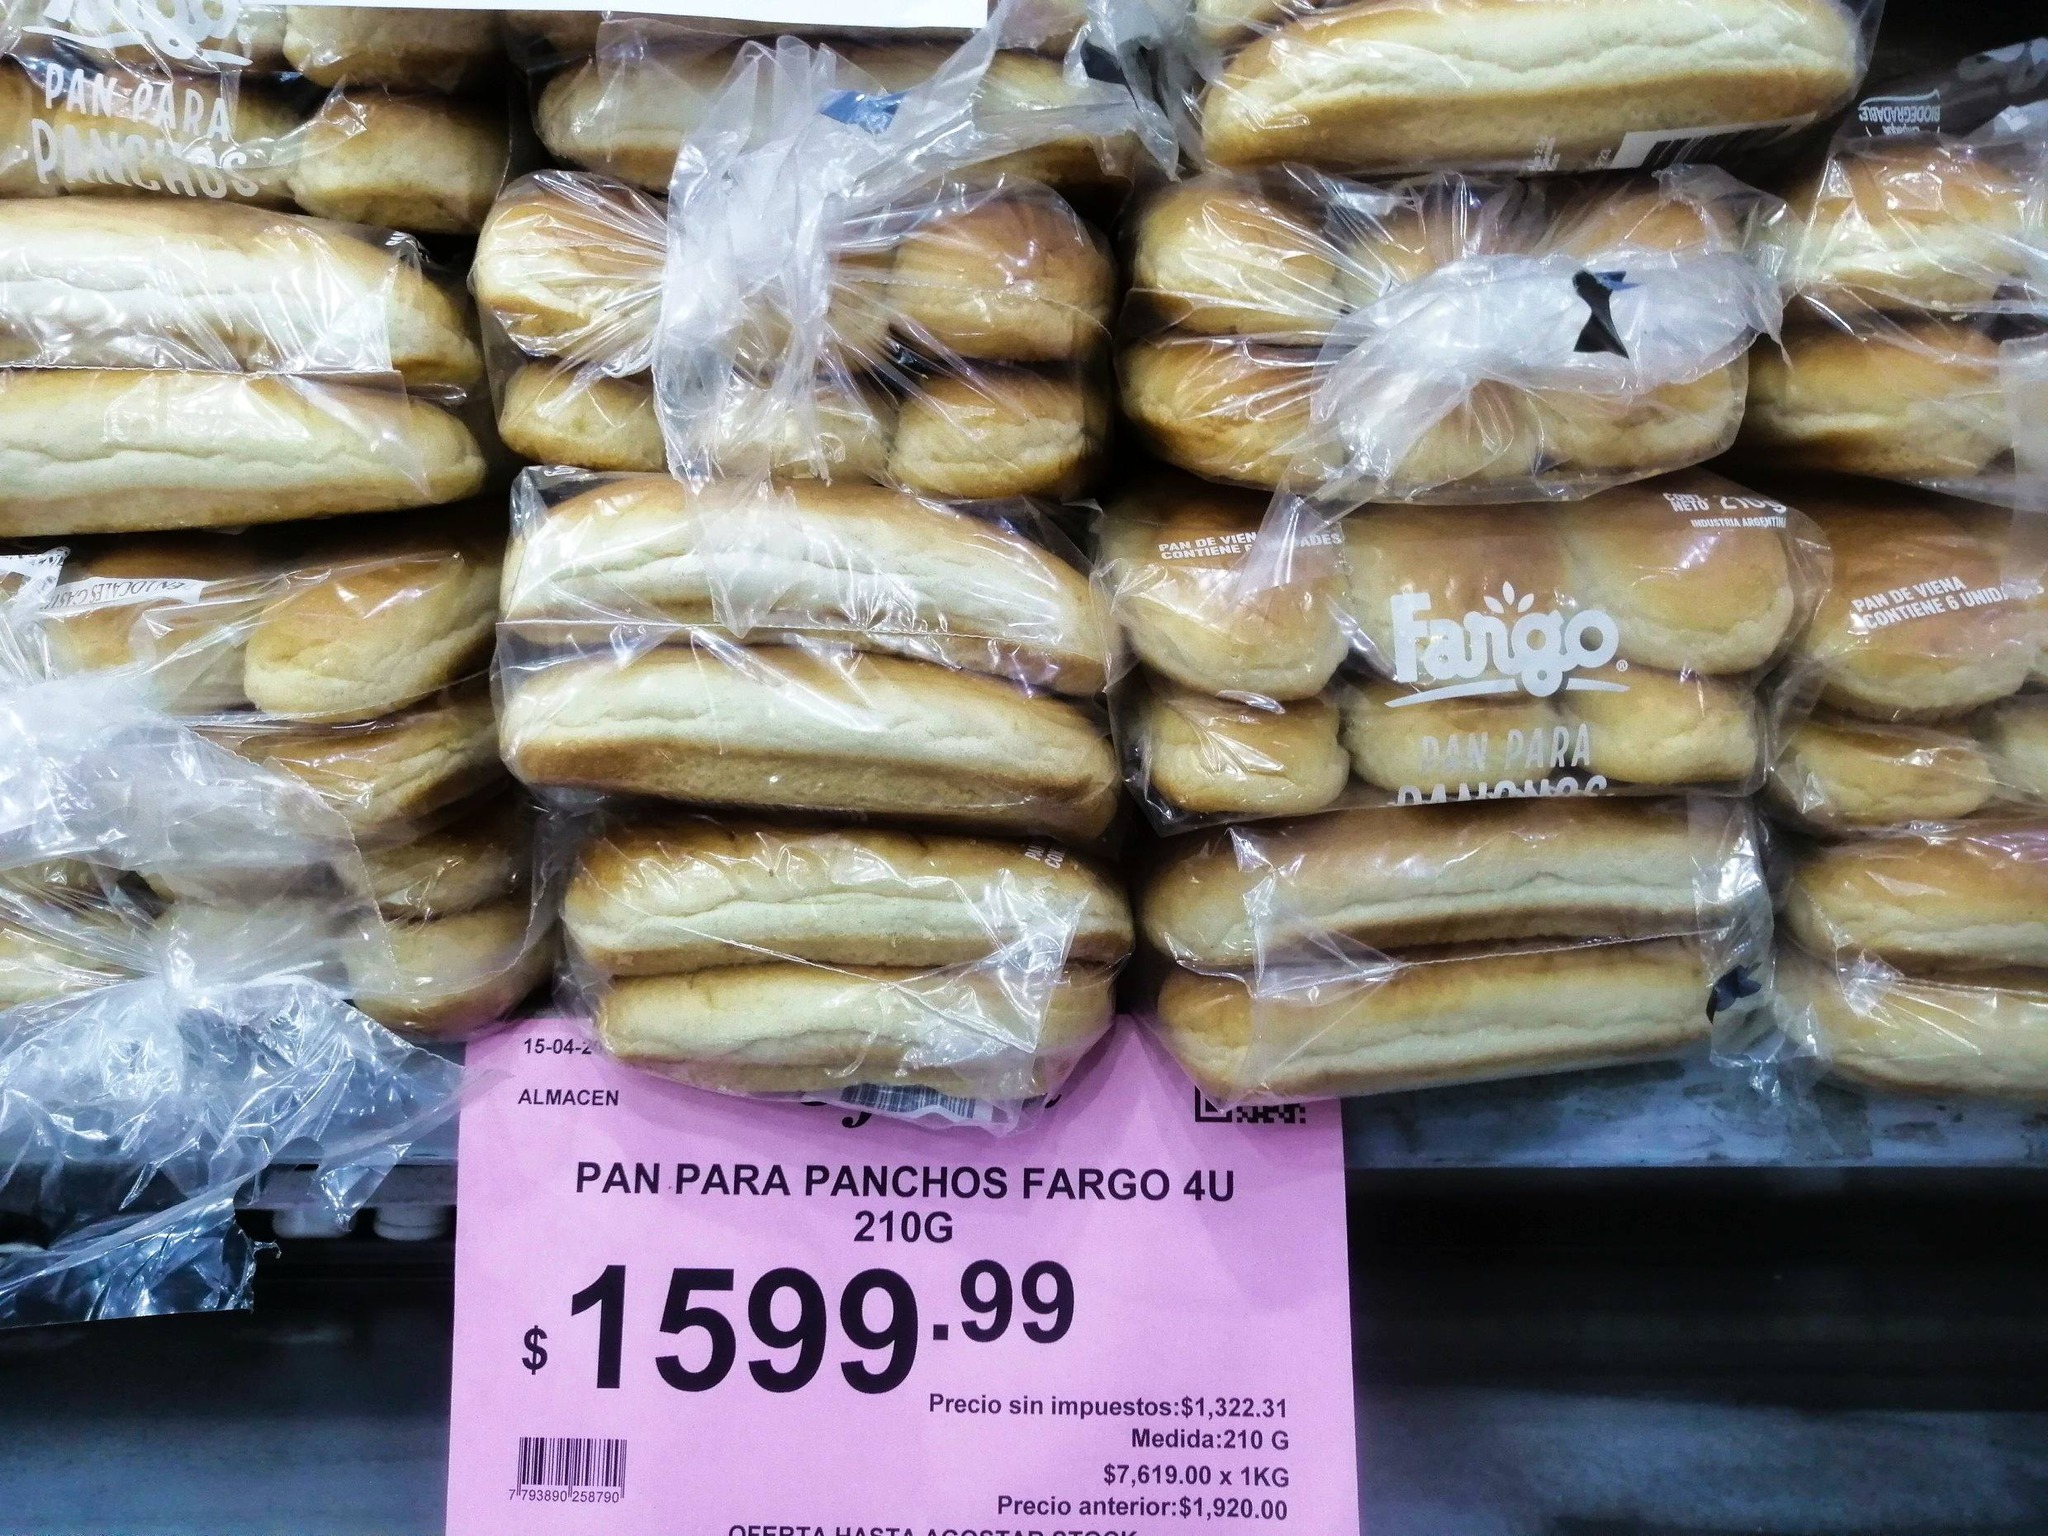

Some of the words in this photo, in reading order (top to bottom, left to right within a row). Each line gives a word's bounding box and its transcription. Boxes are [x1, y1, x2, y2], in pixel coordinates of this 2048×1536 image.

[45, 63, 118, 118] PAN
[132, 82, 230, 142] PARA
[31, 118, 259, 199] PANCHOS
[1670, 500, 1709, 512] NETO
[1690, 518, 1741, 528] INDUSTRIA
[1158, 541, 1191, 552] PAN
[1195, 537, 1216, 548] DE
[1220, 531, 1257, 545] VIEN
[1161, 544, 1241, 560] CONTIENE
[1851, 592, 1889, 613] PAN
[1888, 587, 1914, 604] DE
[1913, 576, 1967, 598] VIENA
[1862, 597, 1946, 630] CONTIENE
[1945, 595, 1960, 610] 6
[1391, 592, 1619, 697] Fargo
[1421, 731, 1489, 773] PAN
[1504, 722, 1590, 770] PARA
[524, 1038, 594, 1054] 15-04-2
[518, 1089, 619, 1105] ALMACEN
[576, 1162, 660, 1193] PAN
[676, 1163, 790, 1195] PARA
[806, 1165, 1007, 1198] PANCHOS
[1024, 1168, 1169, 1200] FARGO
[1184, 1170, 1233, 1202] 4U
[854, 1210, 952, 1243] 210G
[522, 1325, 548, 1375] $
[930, 1394, 1001, 1414] Precio
[1010, 1396, 1043, 1414] sin
[1272, 1431, 1289, 1450] G
[1104, 1464, 1211, 1488] $7,619.00
[1220, 1471, 1232, 1485] x
[1241, 1467, 1288, 1487] 1KG
[998, 1495, 1071, 1515] Precio
